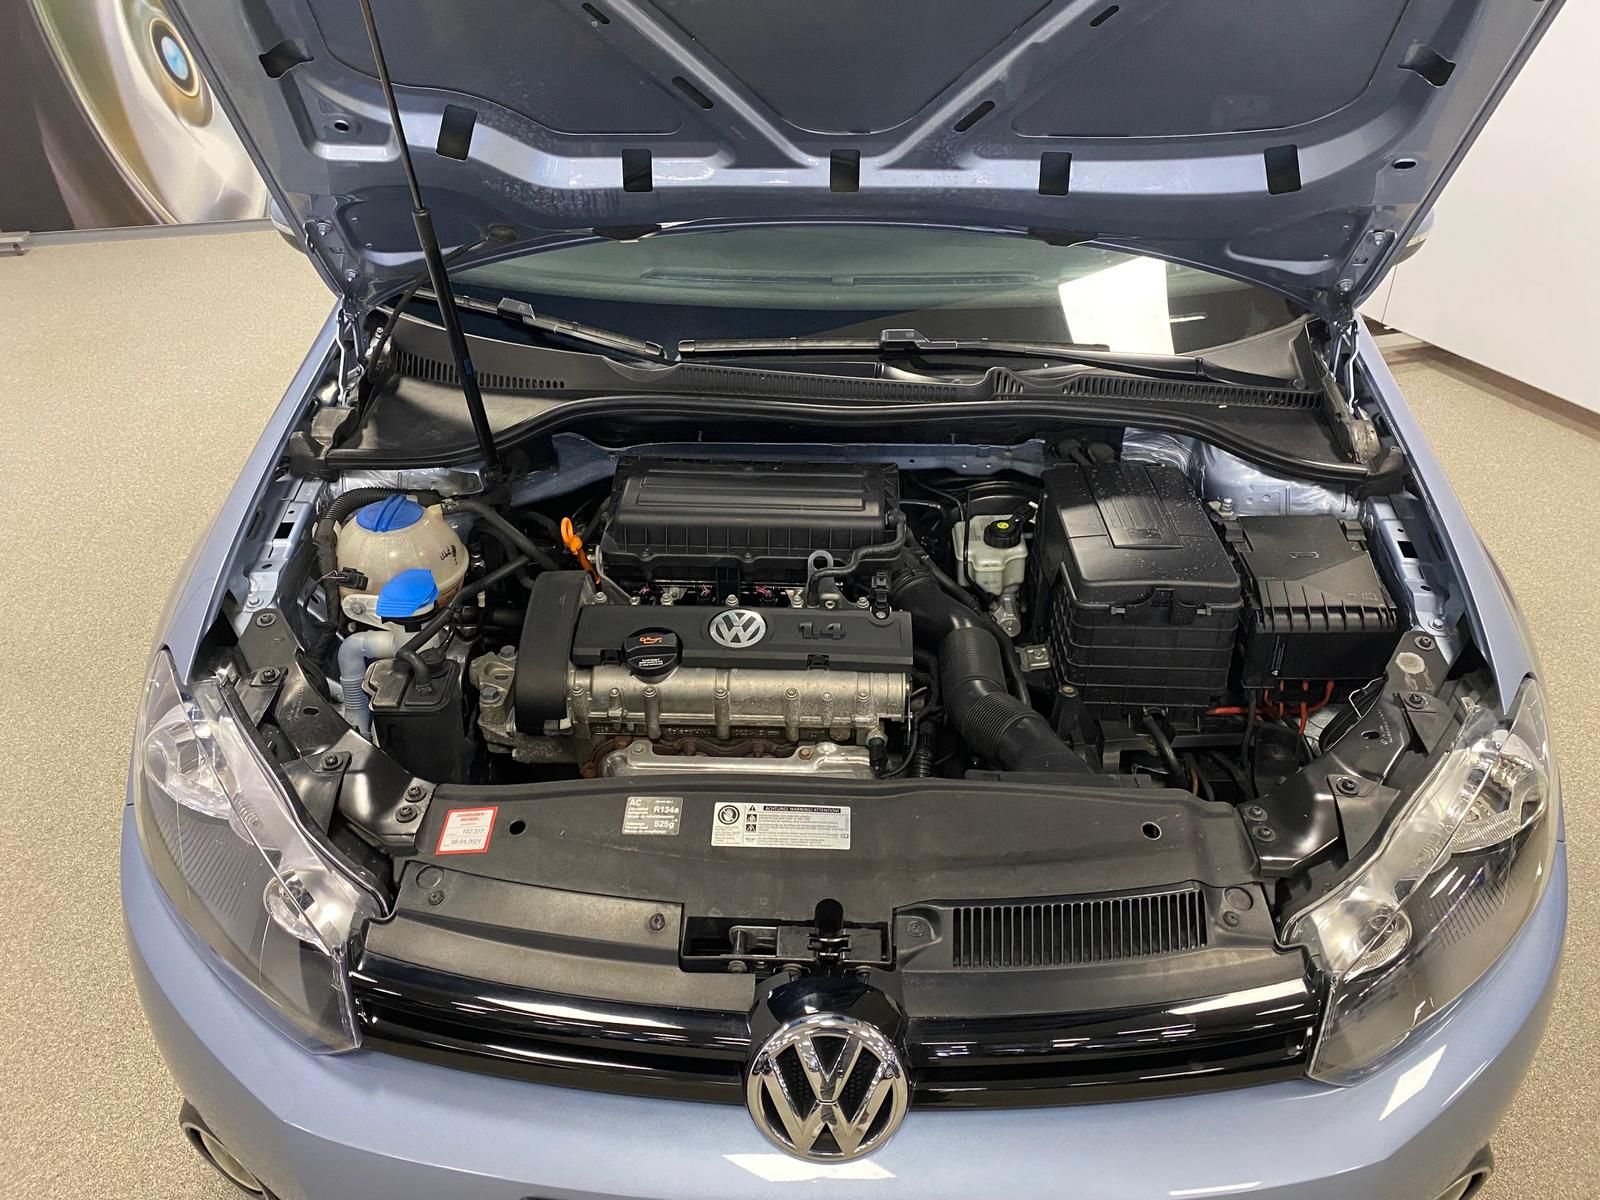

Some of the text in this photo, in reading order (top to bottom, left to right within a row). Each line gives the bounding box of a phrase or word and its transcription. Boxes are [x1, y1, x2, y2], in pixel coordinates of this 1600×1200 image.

[709, 609, 768, 648] VW
[798, 621, 846, 640] 1.4
[629, 799, 642, 807] AC
[747, 1012, 908, 1163] VW
